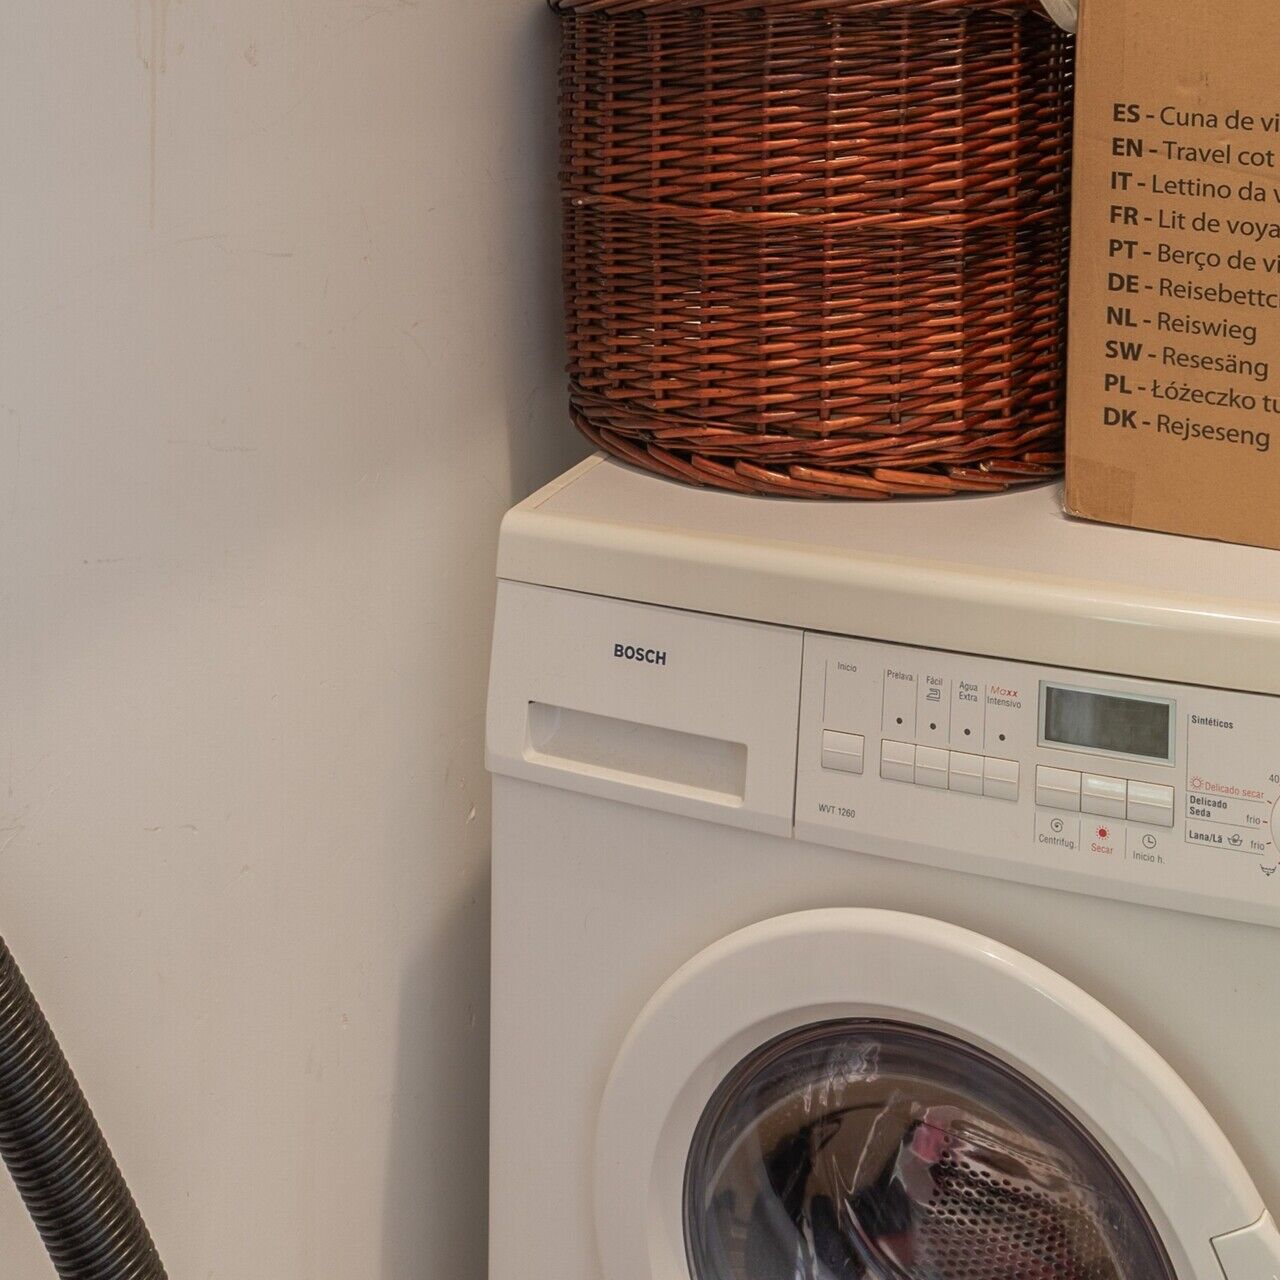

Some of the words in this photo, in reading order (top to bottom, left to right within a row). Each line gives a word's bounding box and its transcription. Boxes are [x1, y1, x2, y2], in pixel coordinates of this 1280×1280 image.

[1113, 103, 1140, 123] ES
[1160, 106, 1218, 128] Cuna
[1225, 110, 1254, 131] de
[1112, 137, 1143, 158] EN
[1163, 141, 1231, 164] Travel
[1237, 148, 1275, 167] cot
[1111, 171, 1132, 190] IT
[1152, 174, 1232, 199] Lettino
[1238, 181, 1267, 202] da
[1110, 205, 1139, 225] FR
[1159, 209, 1186, 230] Lit
[1191, 212, 1220, 233] de
[1109, 239, 1138, 259] PT
[1158, 244, 1220, 271] Berço
[1227, 250, 1256, 271] de
[1108, 272, 1139, 293] DE
[1106, 306, 1138, 327] NL
[1158, 312, 1257, 345] Reiswieg
[1105, 340, 1143, 361] SW
[1162, 346, 1269, 381] Resesäng
[1104, 374, 1132, 394] PL
[1151, 379, 1256, 410] Łóżeczko
[1103, 407, 1137, 429] DK
[1157, 414, 1270, 452] Rejseseng
[614, 643, 667, 666] BOSCH
[959, 681, 978, 692] Agua
[959, 691, 978, 702] Extra
[987, 696, 1022, 709] Intensivo
[1191, 715, 1234, 729] Sintéticos
[1269, 774, 1280, 784] 40
[1205, 781, 1239, 796] Delicado
[1242, 788, 1264, 799] secar
[818, 803, 836, 815] WVT
[838, 807, 856, 818] 1260
[1189, 806, 1211, 817] Seda
[1190, 795, 1228, 809] Delicado
[1091, 843, 1114, 854] Secar
